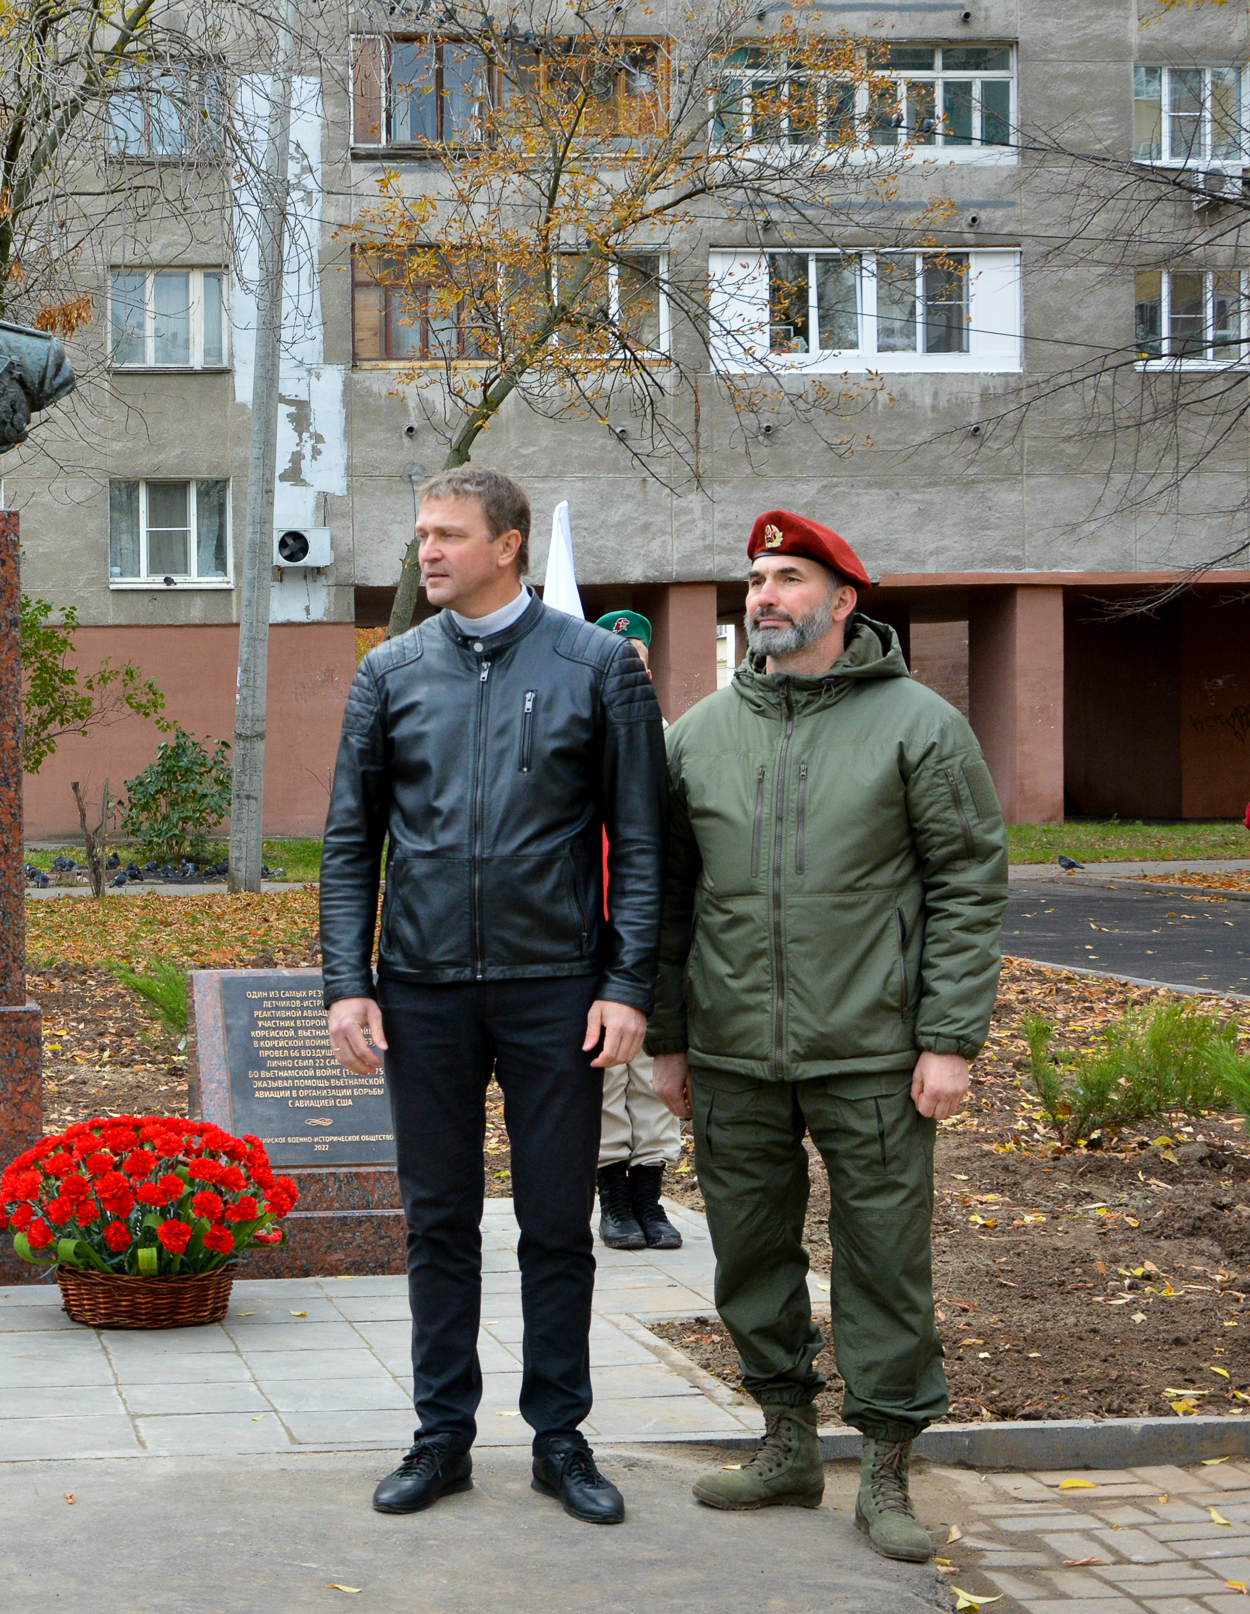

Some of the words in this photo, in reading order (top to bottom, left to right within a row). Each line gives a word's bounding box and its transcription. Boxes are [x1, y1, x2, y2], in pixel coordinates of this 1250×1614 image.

[246, 991, 268, 999] ОДИН
[254, 1009, 302, 1018] РЕАКТИВНОЙ
[296, 1018, 326, 1027] ВТОРОЙ
[251, 1029, 297, 1038] КОРЕЙСКОЙ,
[260, 1039, 304, 1047] КОРЕЙСКОЙ
[305, 1038, 330, 1046] ВОЙНЕ
[301, 1048, 334, 1057] ВОЗДУШ
[261, 1068, 314, 1078] ВЬЕТНАМСКОЙ
[316, 1068, 341, 1076] ВОЙНЕ
[253, 1080, 293, 1088] ОКАЗЫВАЛ
[330, 1077, 384, 1086] ВЬЕТНАМСКОЙ
[254, 1090, 290, 1098] АВИАЦИИ
[298, 1089, 352, 1097] ОРГАНИЗАЦИИ
[295, 1098, 334, 1108] АВИАЦИЕЙ
